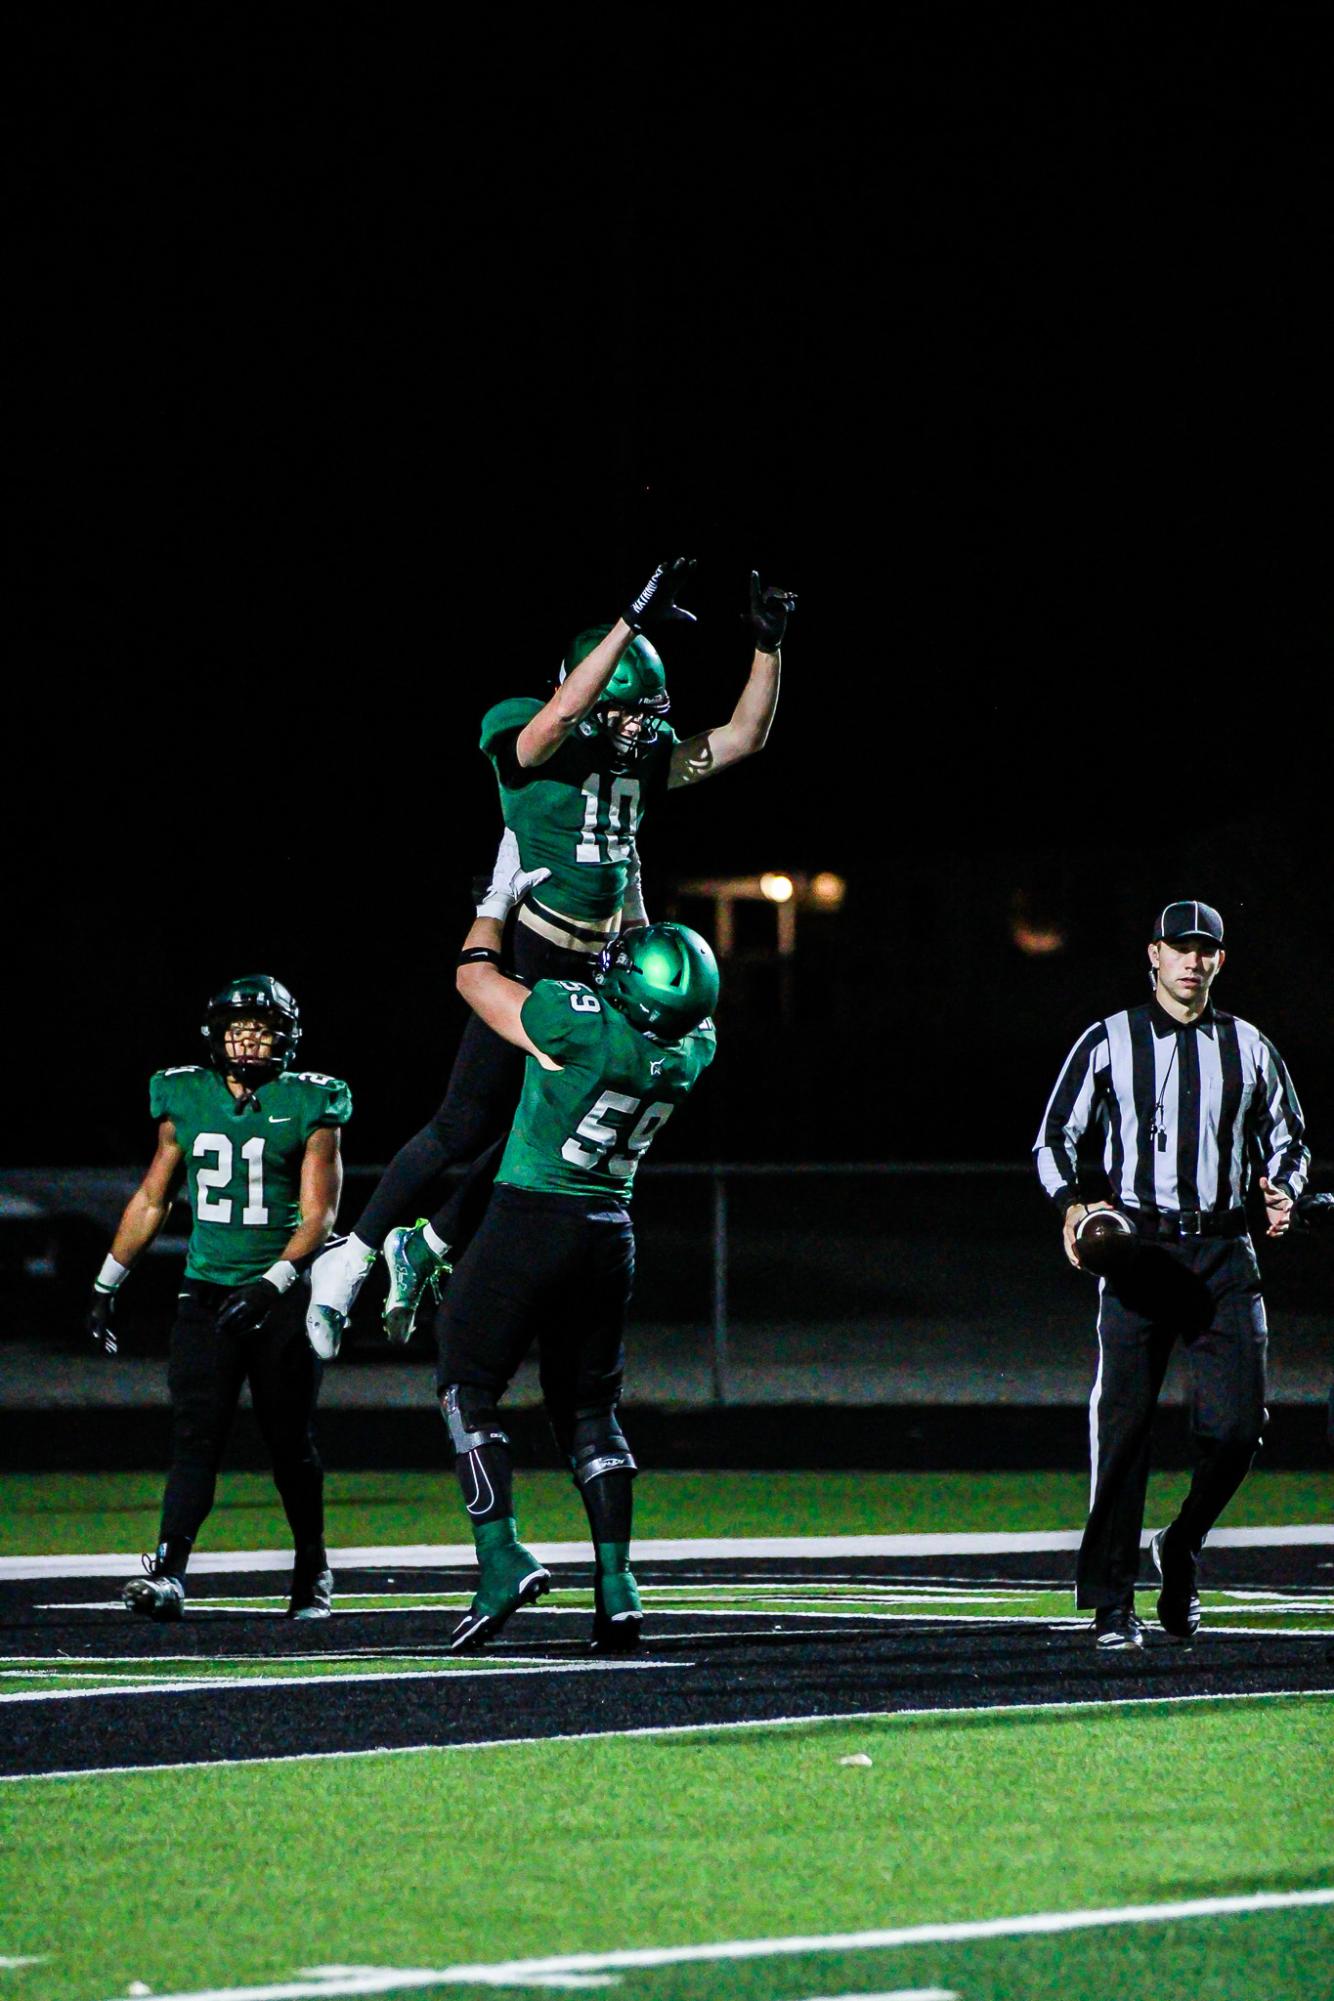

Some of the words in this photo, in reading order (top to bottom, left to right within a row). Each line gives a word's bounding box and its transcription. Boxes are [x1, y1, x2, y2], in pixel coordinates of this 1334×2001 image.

[576, 772, 640, 862] 10
[192, 1132, 269, 1224] 21
[561, 1090, 674, 1177] 59
